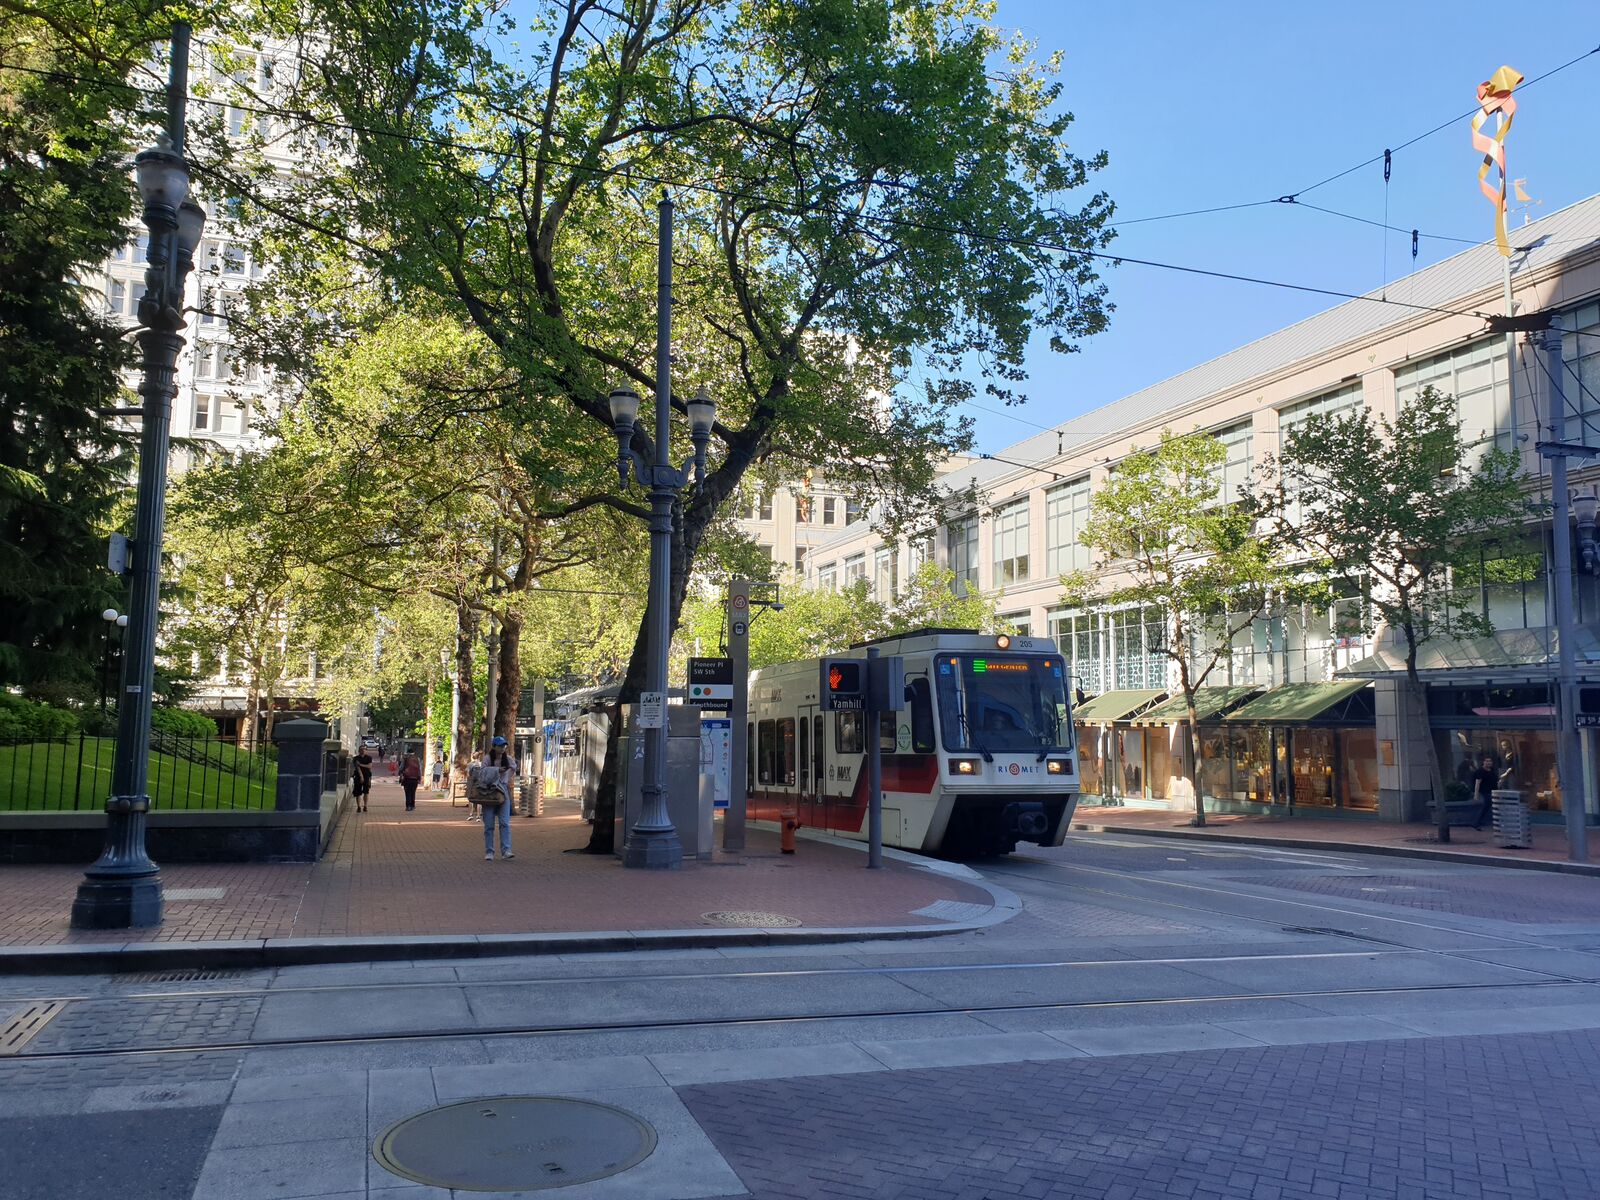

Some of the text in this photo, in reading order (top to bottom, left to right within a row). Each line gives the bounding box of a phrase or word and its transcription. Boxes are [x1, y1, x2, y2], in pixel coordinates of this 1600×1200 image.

[1020, 640, 1032, 648] 205
[833, 699, 862, 709] Yamhill
[837, 766, 851, 779] MAX
